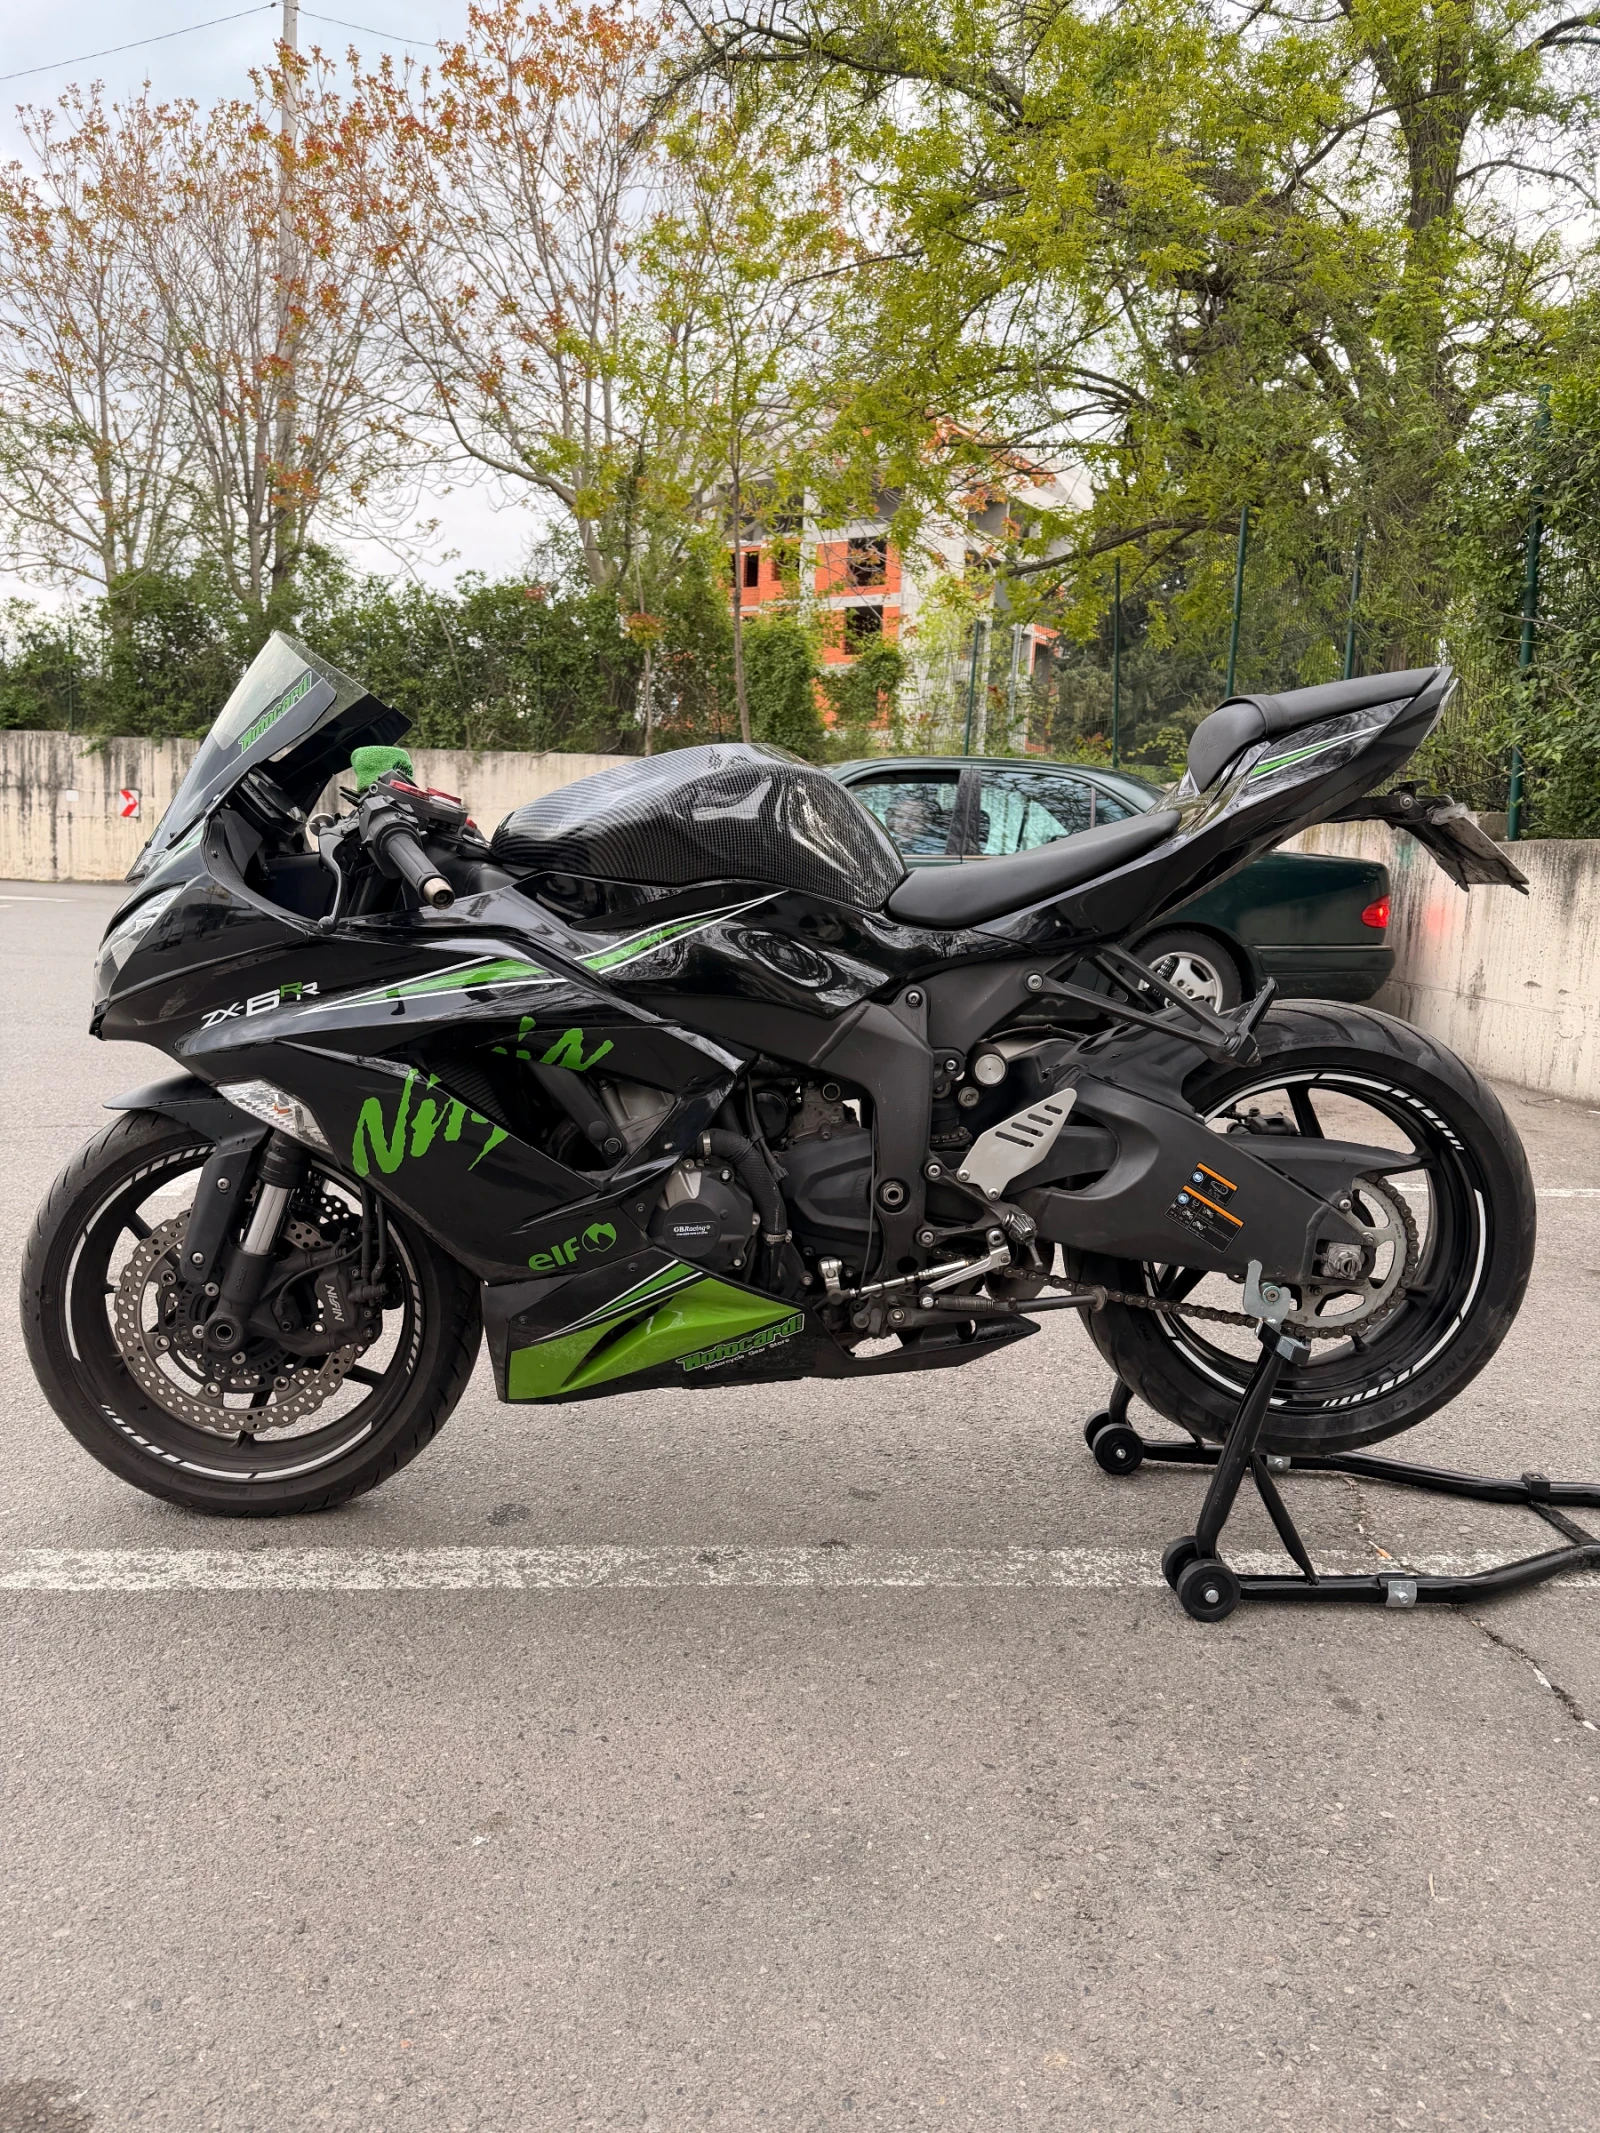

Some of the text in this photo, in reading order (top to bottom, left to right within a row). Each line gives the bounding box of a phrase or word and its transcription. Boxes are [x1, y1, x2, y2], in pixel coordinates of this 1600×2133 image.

[528, 1236, 580, 1271] elf
[325, 1284, 345, 1322] NISSIN
[704, 1338, 790, 1371] Motorcycle Gear Store
